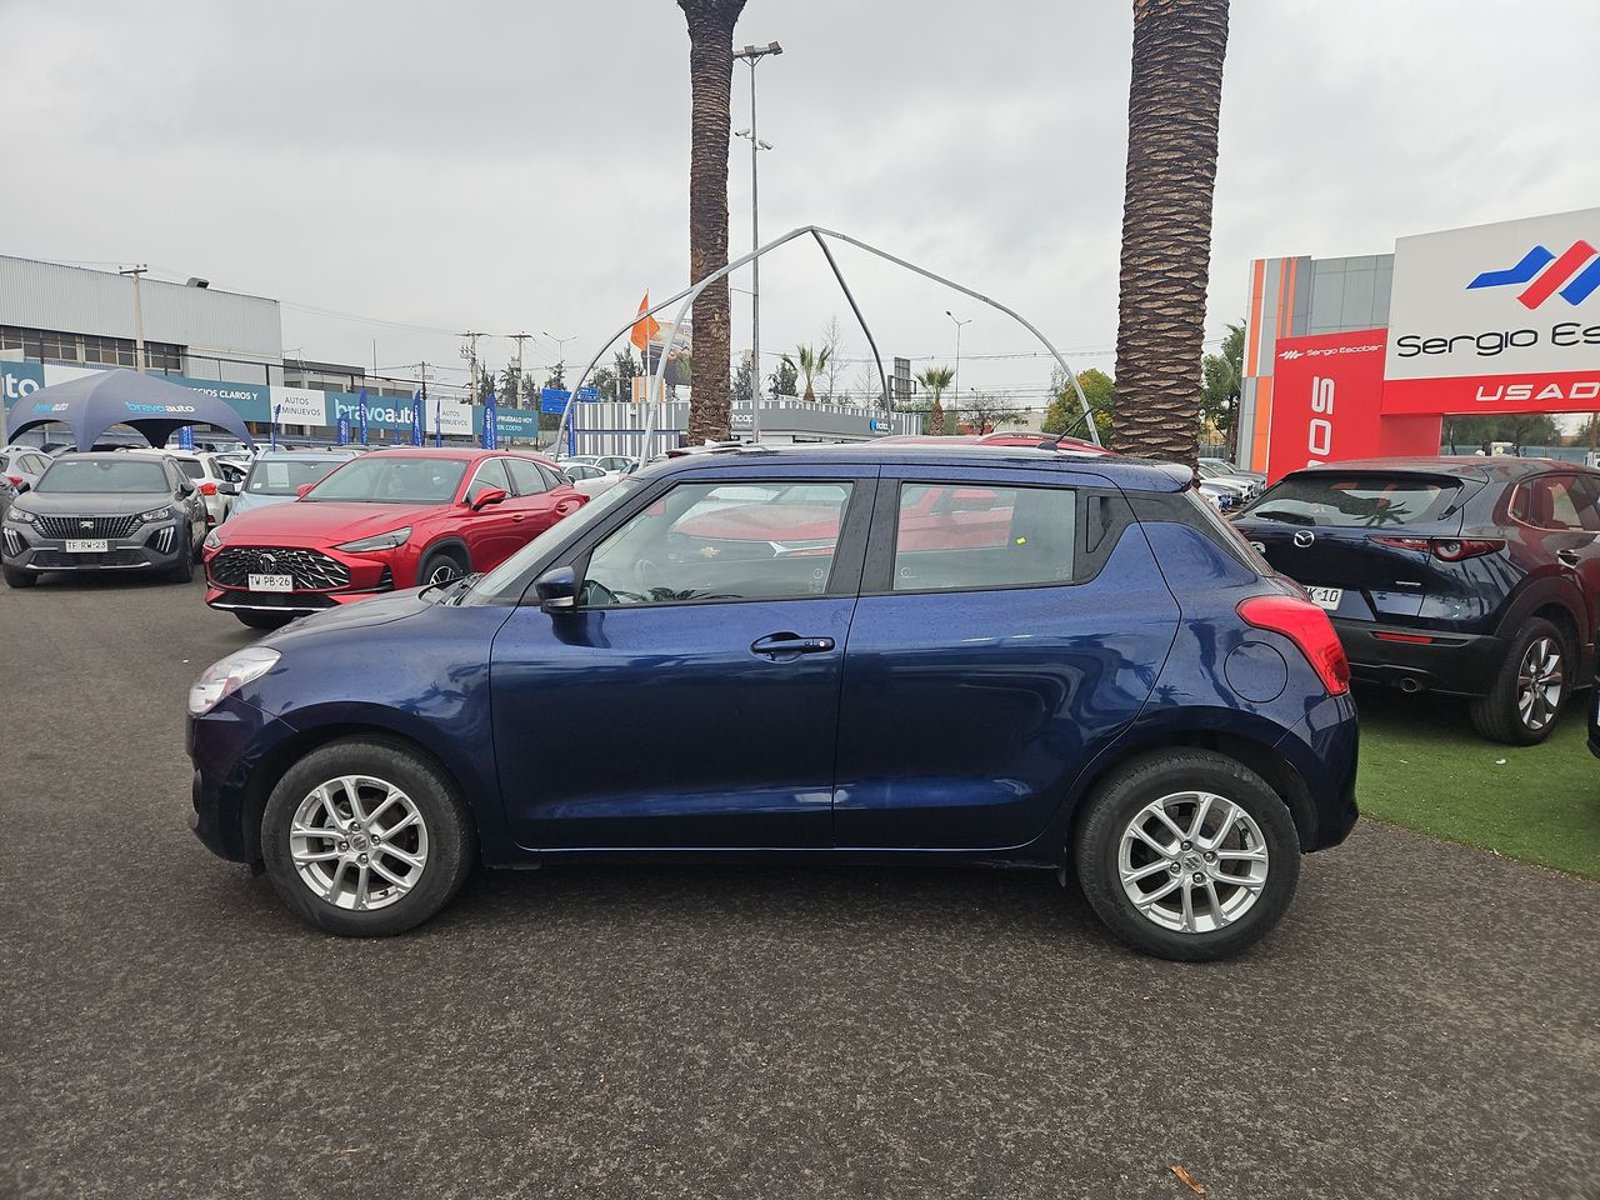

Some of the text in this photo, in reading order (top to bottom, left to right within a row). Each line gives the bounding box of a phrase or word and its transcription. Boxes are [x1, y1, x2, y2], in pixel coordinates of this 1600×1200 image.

[1396, 322, 1600, 357] Sergio Es
[1306, 344, 1384, 357] Sergio Escobar
[1, 373, 39, 398] to
[1475, 383, 1600, 401] USAD
[219, 389, 251, 400] CLAROS
[252, 393, 259, 401] Y
[284, 396, 310, 405] AUTOS
[125, 401, 195, 413] bravoauto
[1307, 376, 1335, 468] OS
